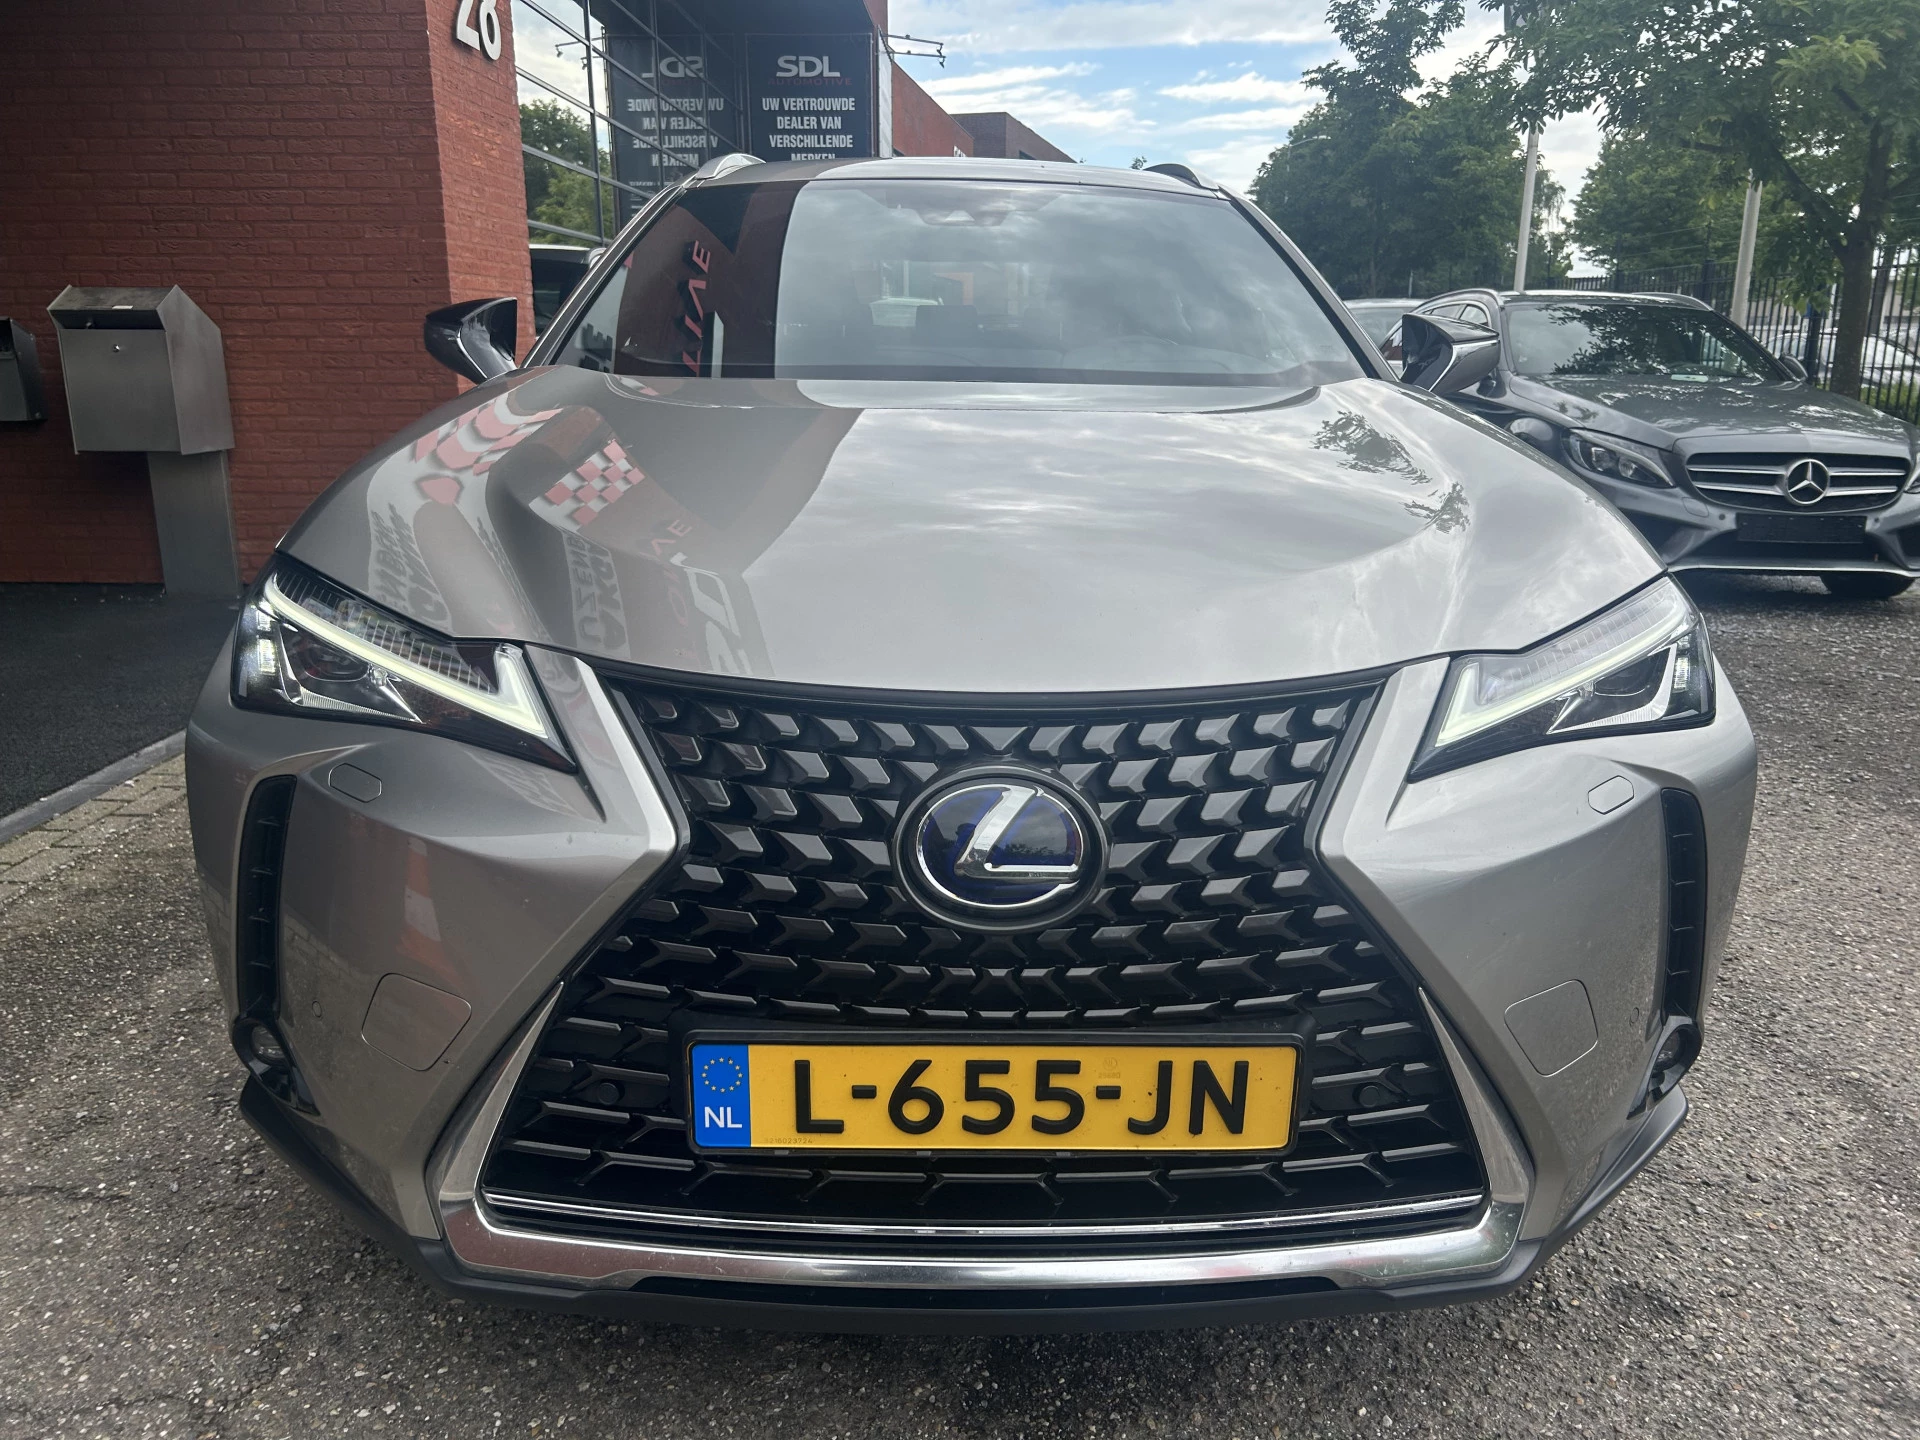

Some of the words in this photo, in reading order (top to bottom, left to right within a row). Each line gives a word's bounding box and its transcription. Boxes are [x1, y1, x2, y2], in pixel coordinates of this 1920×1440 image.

[776, 56, 840, 78] SDL
[767, 78, 852, 86] AUTOMOTIVE
[762, 97, 780, 111] UW
[782, 97, 856, 111] VERTROUWDE
[777, 116, 818, 130] DEALER
[820, 116, 842, 130] VAN
[769, 134, 854, 148] VERSCHILLENDE
[794, 1059, 1250, 1135] L-655-JN
[704, 1106, 743, 1129] NL
